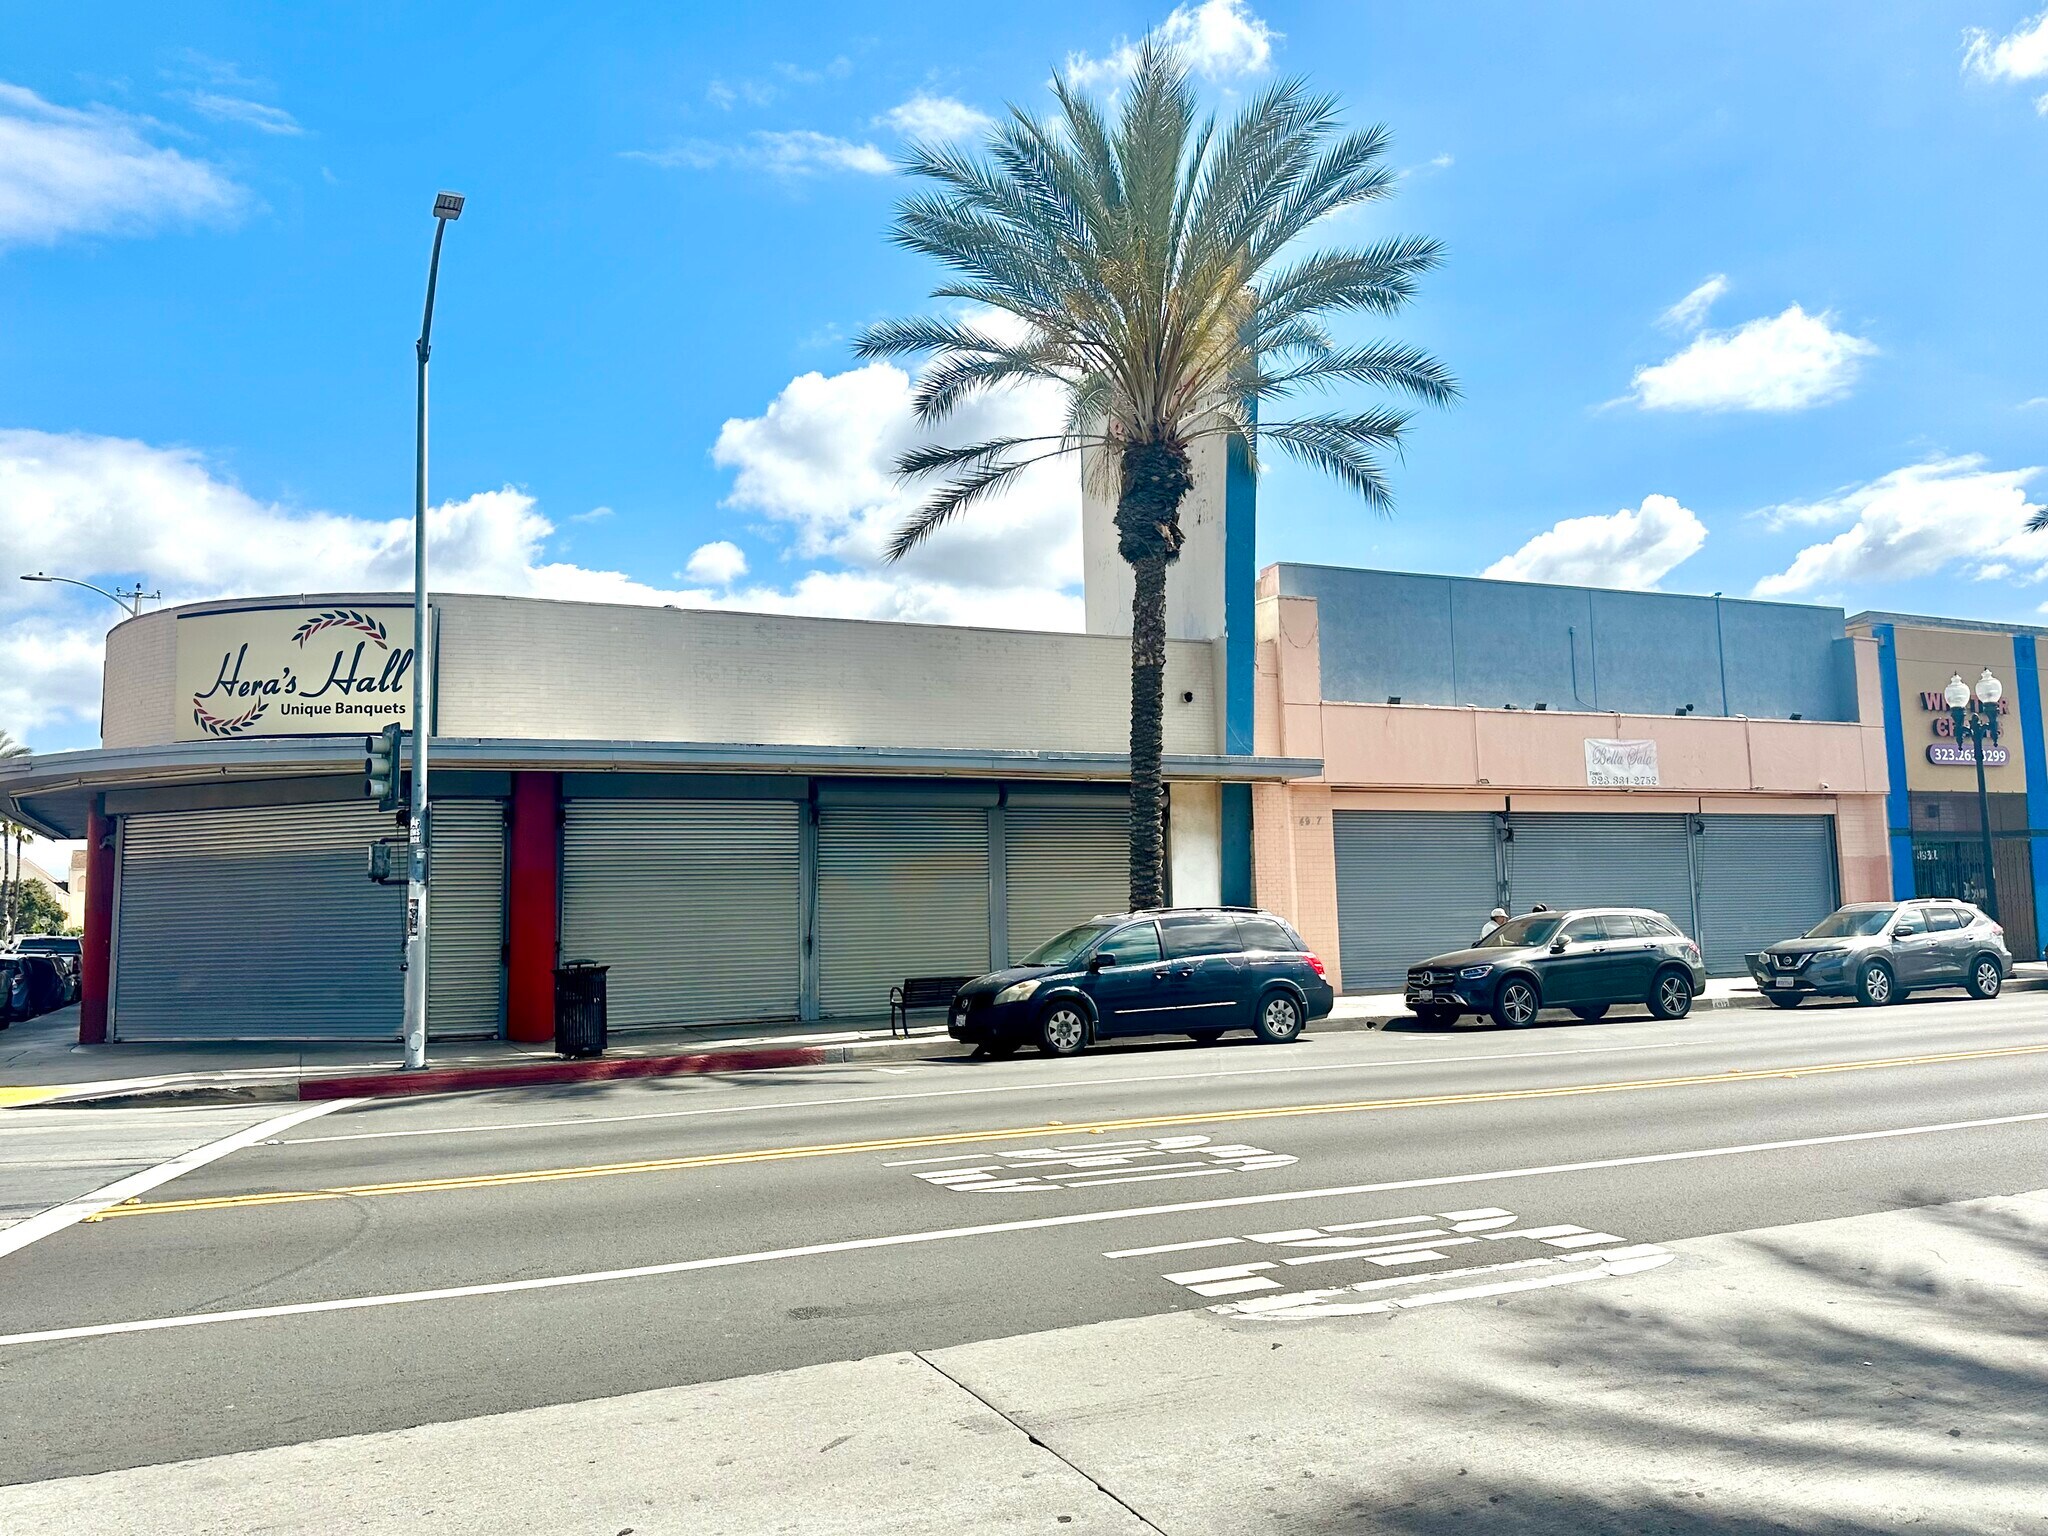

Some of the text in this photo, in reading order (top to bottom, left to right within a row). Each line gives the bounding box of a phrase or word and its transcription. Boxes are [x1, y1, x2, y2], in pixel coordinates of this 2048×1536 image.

[194, 641, 414, 698] Hera's Hall
[280, 702, 406, 718] Unique Banquets
